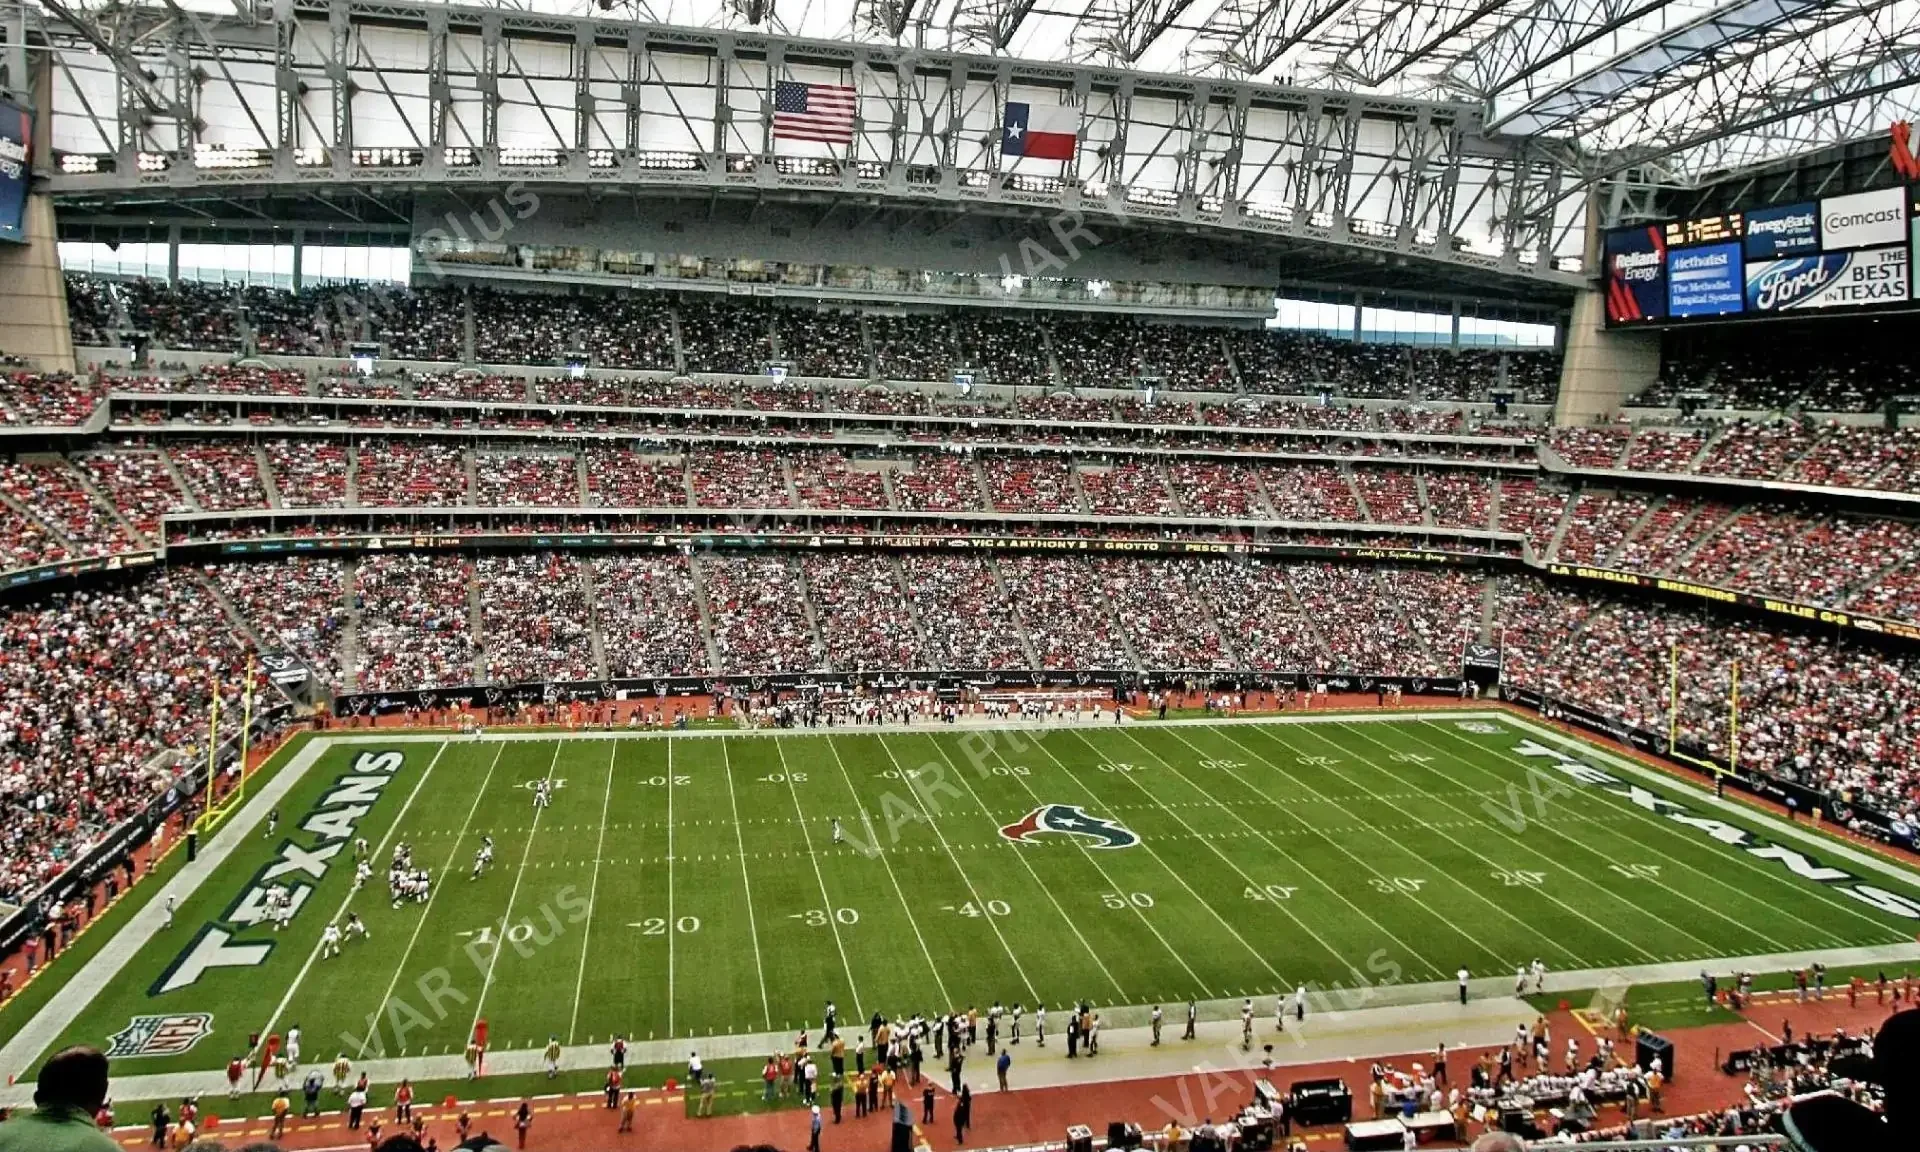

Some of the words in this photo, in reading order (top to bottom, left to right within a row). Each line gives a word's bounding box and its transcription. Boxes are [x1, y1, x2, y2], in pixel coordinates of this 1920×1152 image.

[1615, 250, 1661, 269] Reliant
[1673, 253, 1728, 270] Methodist
[1878, 250, 1906, 262] THE
[1625, 266, 1658, 282] Energy
[1852, 262, 1906, 282] BEST
[1672, 284, 1689, 293] The
[1690, 280, 1731, 292] Methodist
[1757, 255, 1829, 309] Ford
[1824, 292, 1837, 302] IN
[1837, 281, 1905, 301] TEXAS
[1673, 294, 1707, 306] Hospital
[1708, 293, 1741, 304] System
[972, 539, 994, 547] VIC
[1104, 542, 1159, 551] GROTTO
[1185, 544, 1228, 552] PESCE
[1425, 553, 1447, 563] Group
[1550, 565, 1570, 575] LA
[1576, 568, 1639, 585] GRIGLIA
[1764, 600, 1816, 620] WILLIE
[1510, 737, 1920, 922] TEXANS
[148, 748, 406, 997] TEXANS
[958, 899, 1012, 919] 40
[1101, 891, 1155, 911] 50
[641, 915, 701, 936] 20
[804, 907, 860, 926] 30
[143, 1017, 203, 1052] NFL
